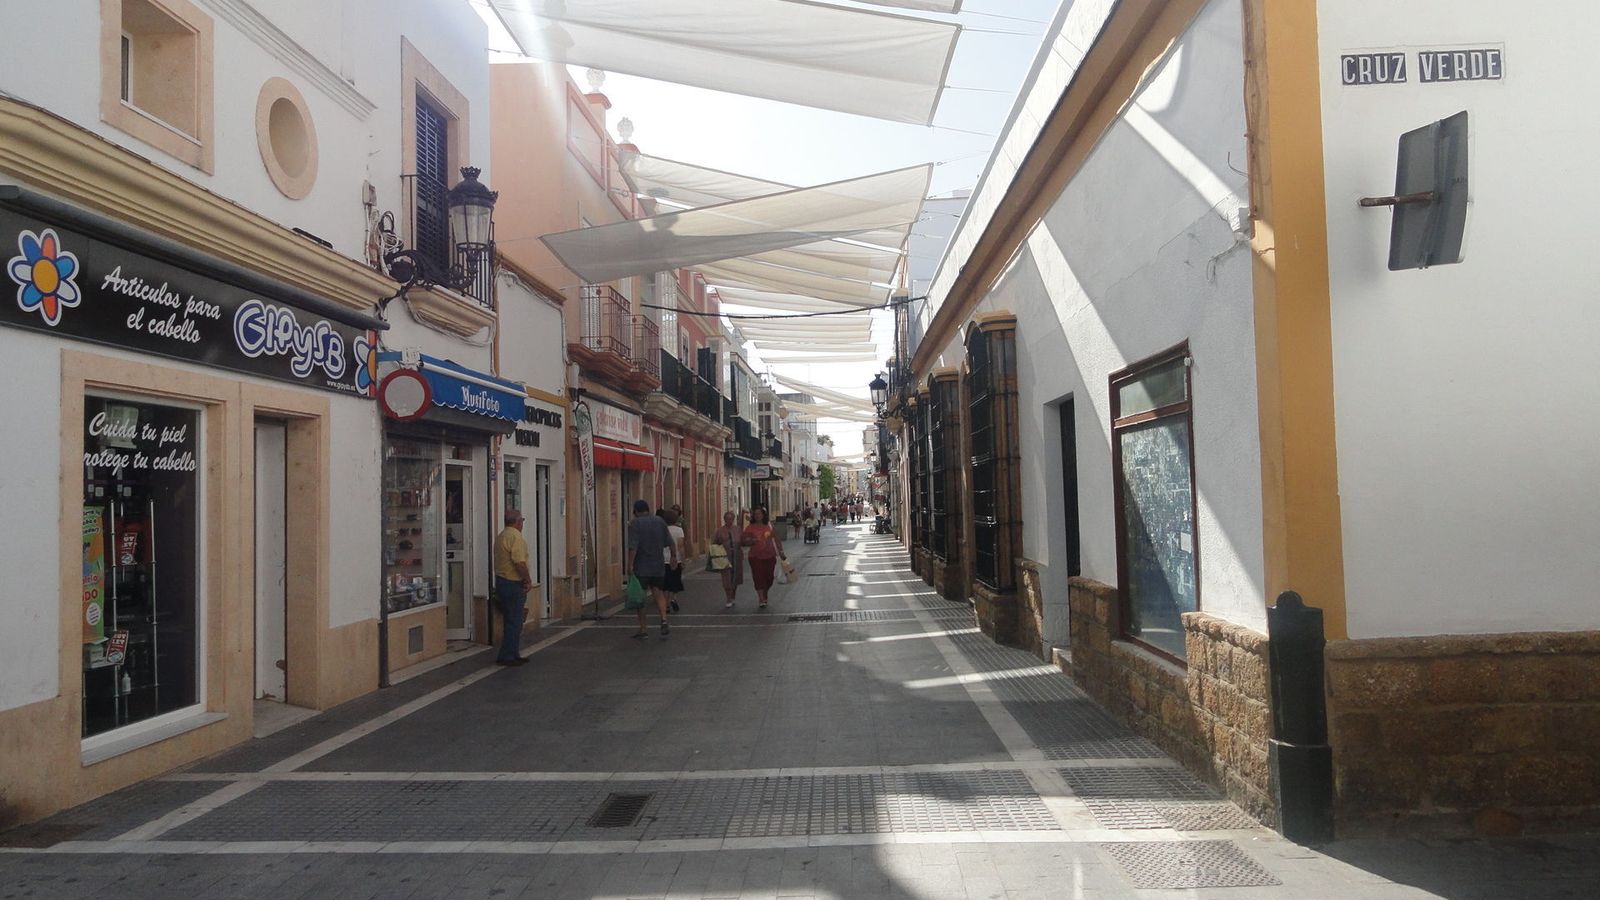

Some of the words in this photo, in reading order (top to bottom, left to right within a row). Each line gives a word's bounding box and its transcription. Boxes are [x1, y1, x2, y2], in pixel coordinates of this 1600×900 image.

[1342, 54, 1406, 84] CRUZ
[1420, 51, 1501, 81] VERDE
[101, 266, 181, 308] Articulos
[184, 296, 221, 319] para
[127, 307, 145, 330] el
[148, 313, 200, 343] cabello
[89, 412, 138, 439] Cuida
[142, 423, 157, 441] tu
[159, 424, 187, 448] piel
[83, 449, 130, 476] rotege
[134, 452, 149, 469] tu
[153, 449, 196, 471] cabello
